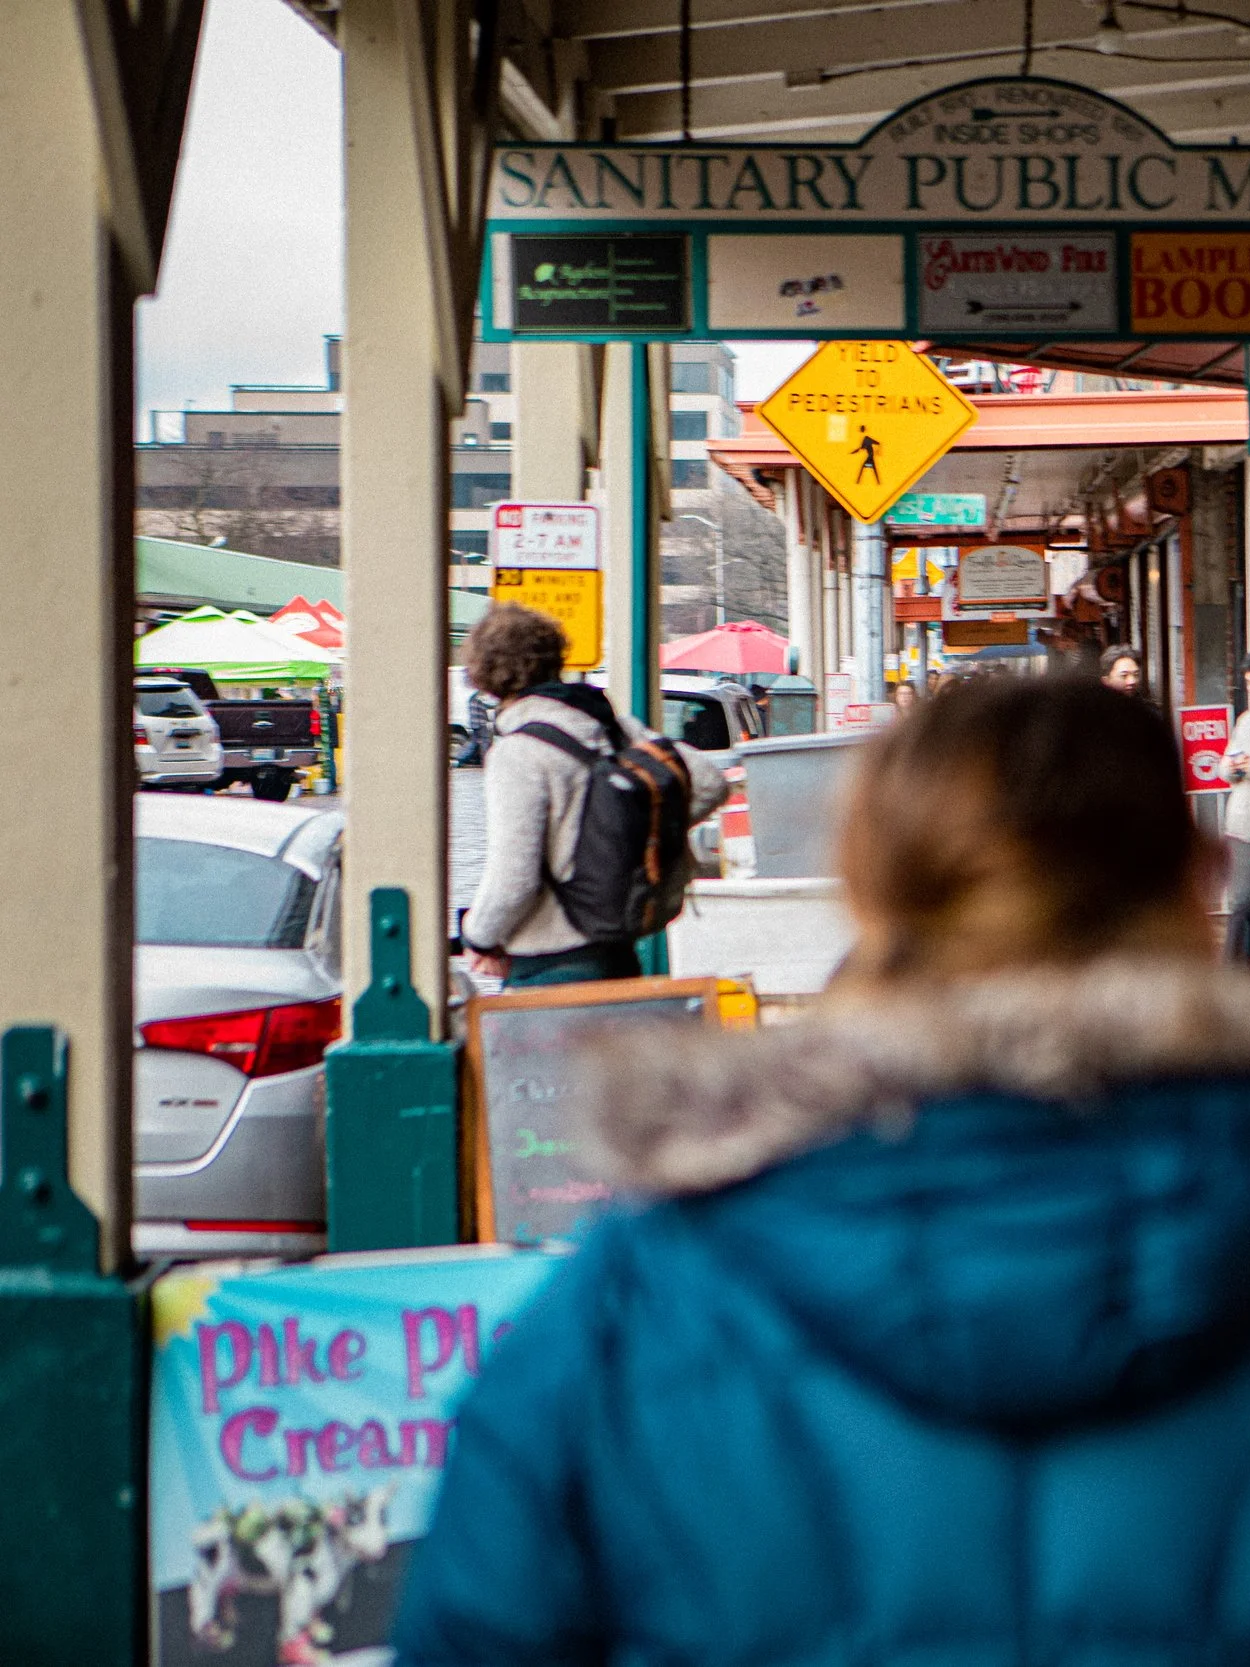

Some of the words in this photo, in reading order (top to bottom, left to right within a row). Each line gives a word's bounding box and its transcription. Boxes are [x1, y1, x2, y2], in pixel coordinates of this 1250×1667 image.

[934, 123, 1011, 145] INSIDE
[1018, 123, 1101, 145] SHOPS
[499, 150, 873, 212] SANITARY
[899, 152, 1177, 212] PUBLIC
[837, 342, 899, 362] YIELD
[854, 369, 880, 388] TO
[787, 392, 945, 415] PEDESTRIANS
[555, 534, 582, 547] AM
[1183, 719, 1228, 742] OPEN
[195, 1315, 368, 1416] Pike
